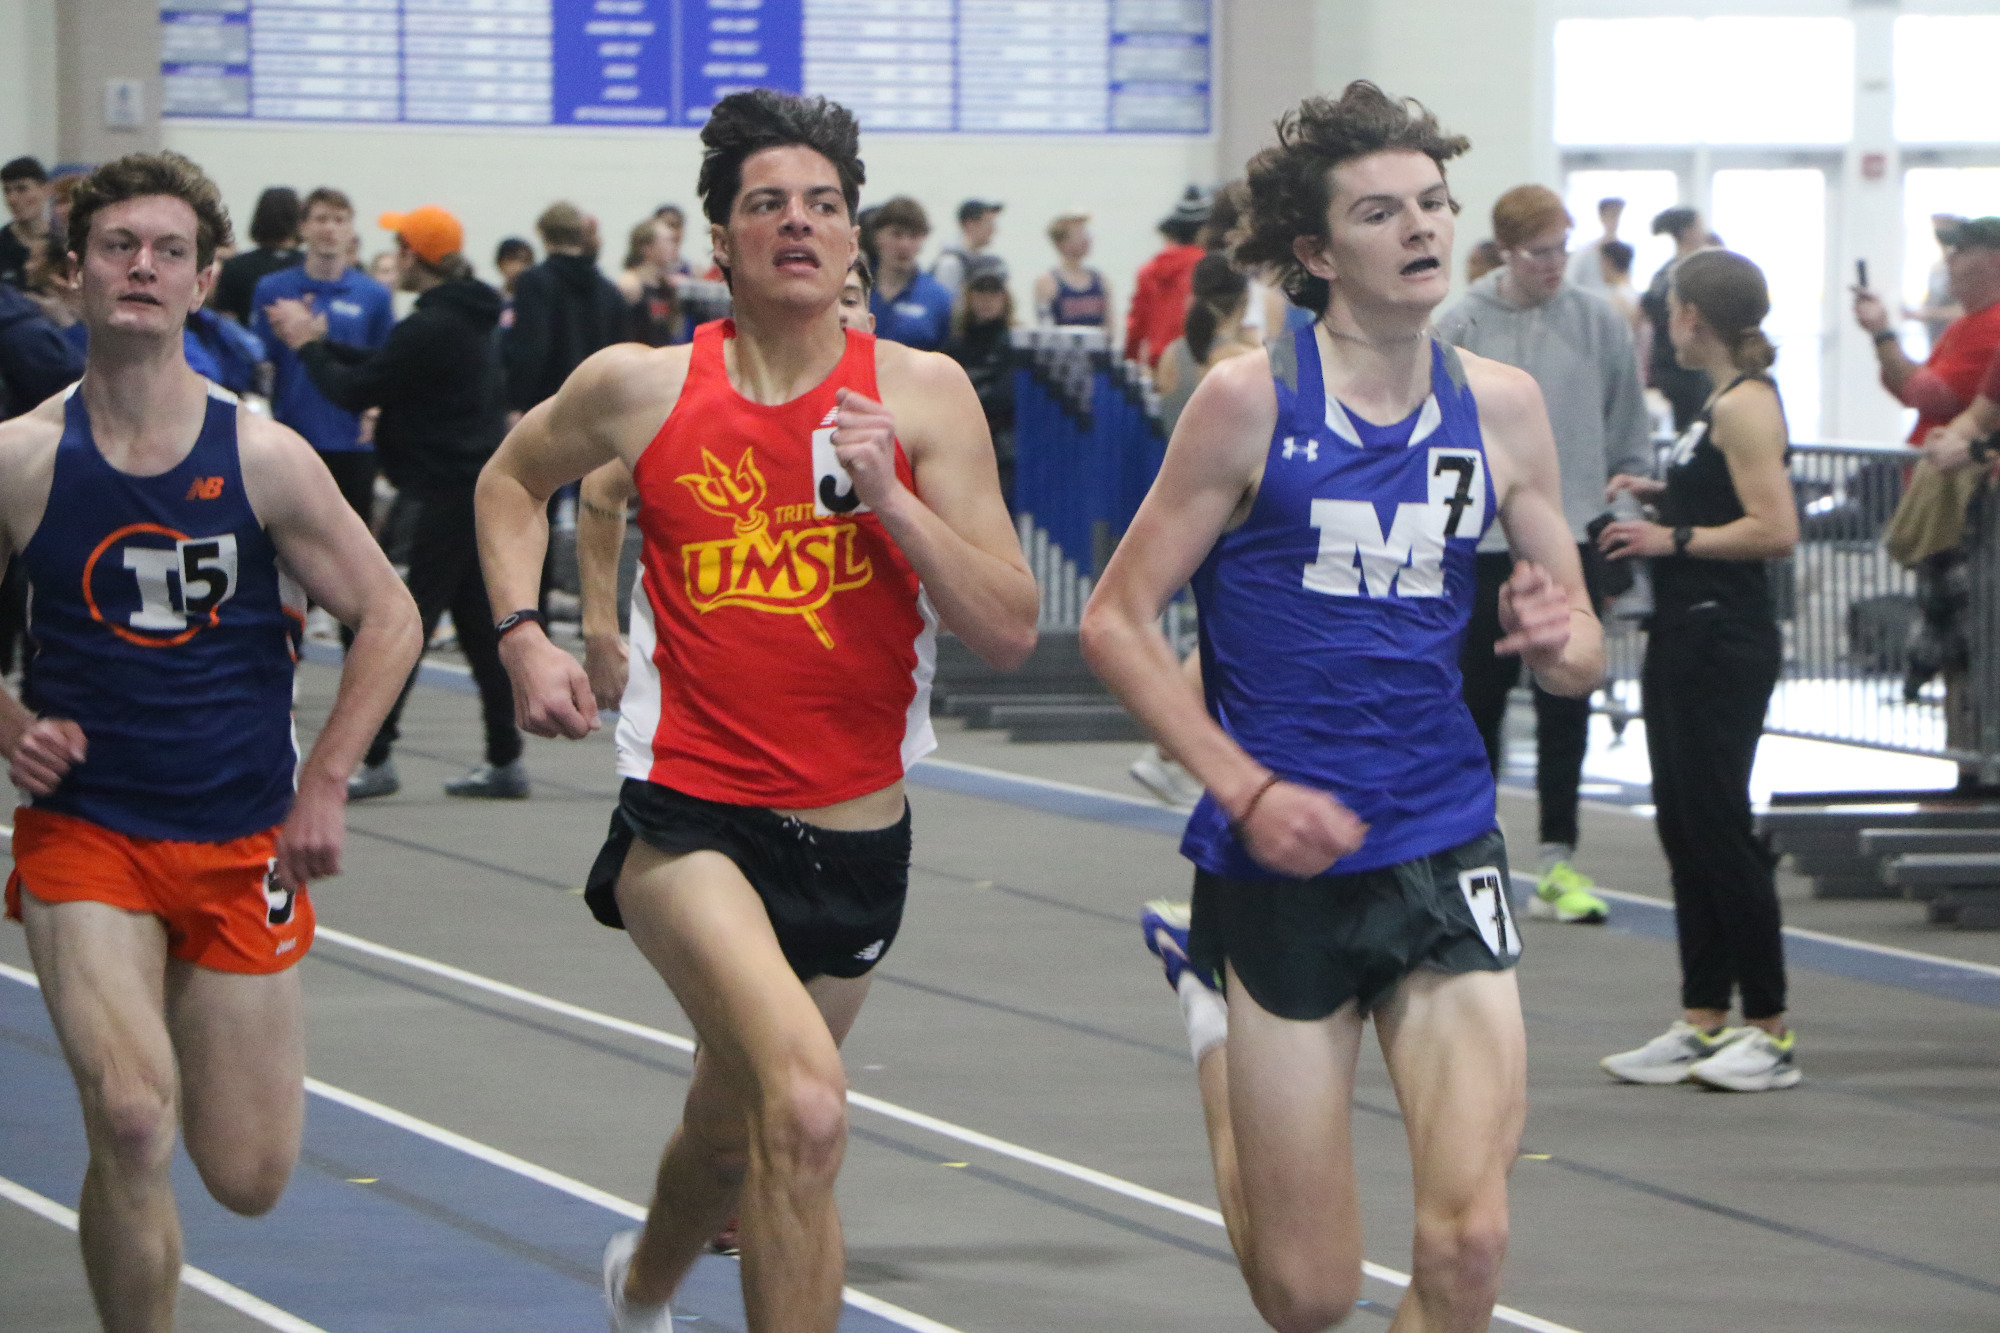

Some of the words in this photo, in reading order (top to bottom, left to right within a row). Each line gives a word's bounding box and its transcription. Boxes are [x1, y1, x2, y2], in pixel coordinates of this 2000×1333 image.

[185, 476, 225, 500] NB
[1434, 456, 1477, 538] 7
[182, 542, 228, 614] 5
[682, 523, 873, 614] UMSL
[1302, 498, 1446, 598] M
[1470, 875, 1508, 955] 7
